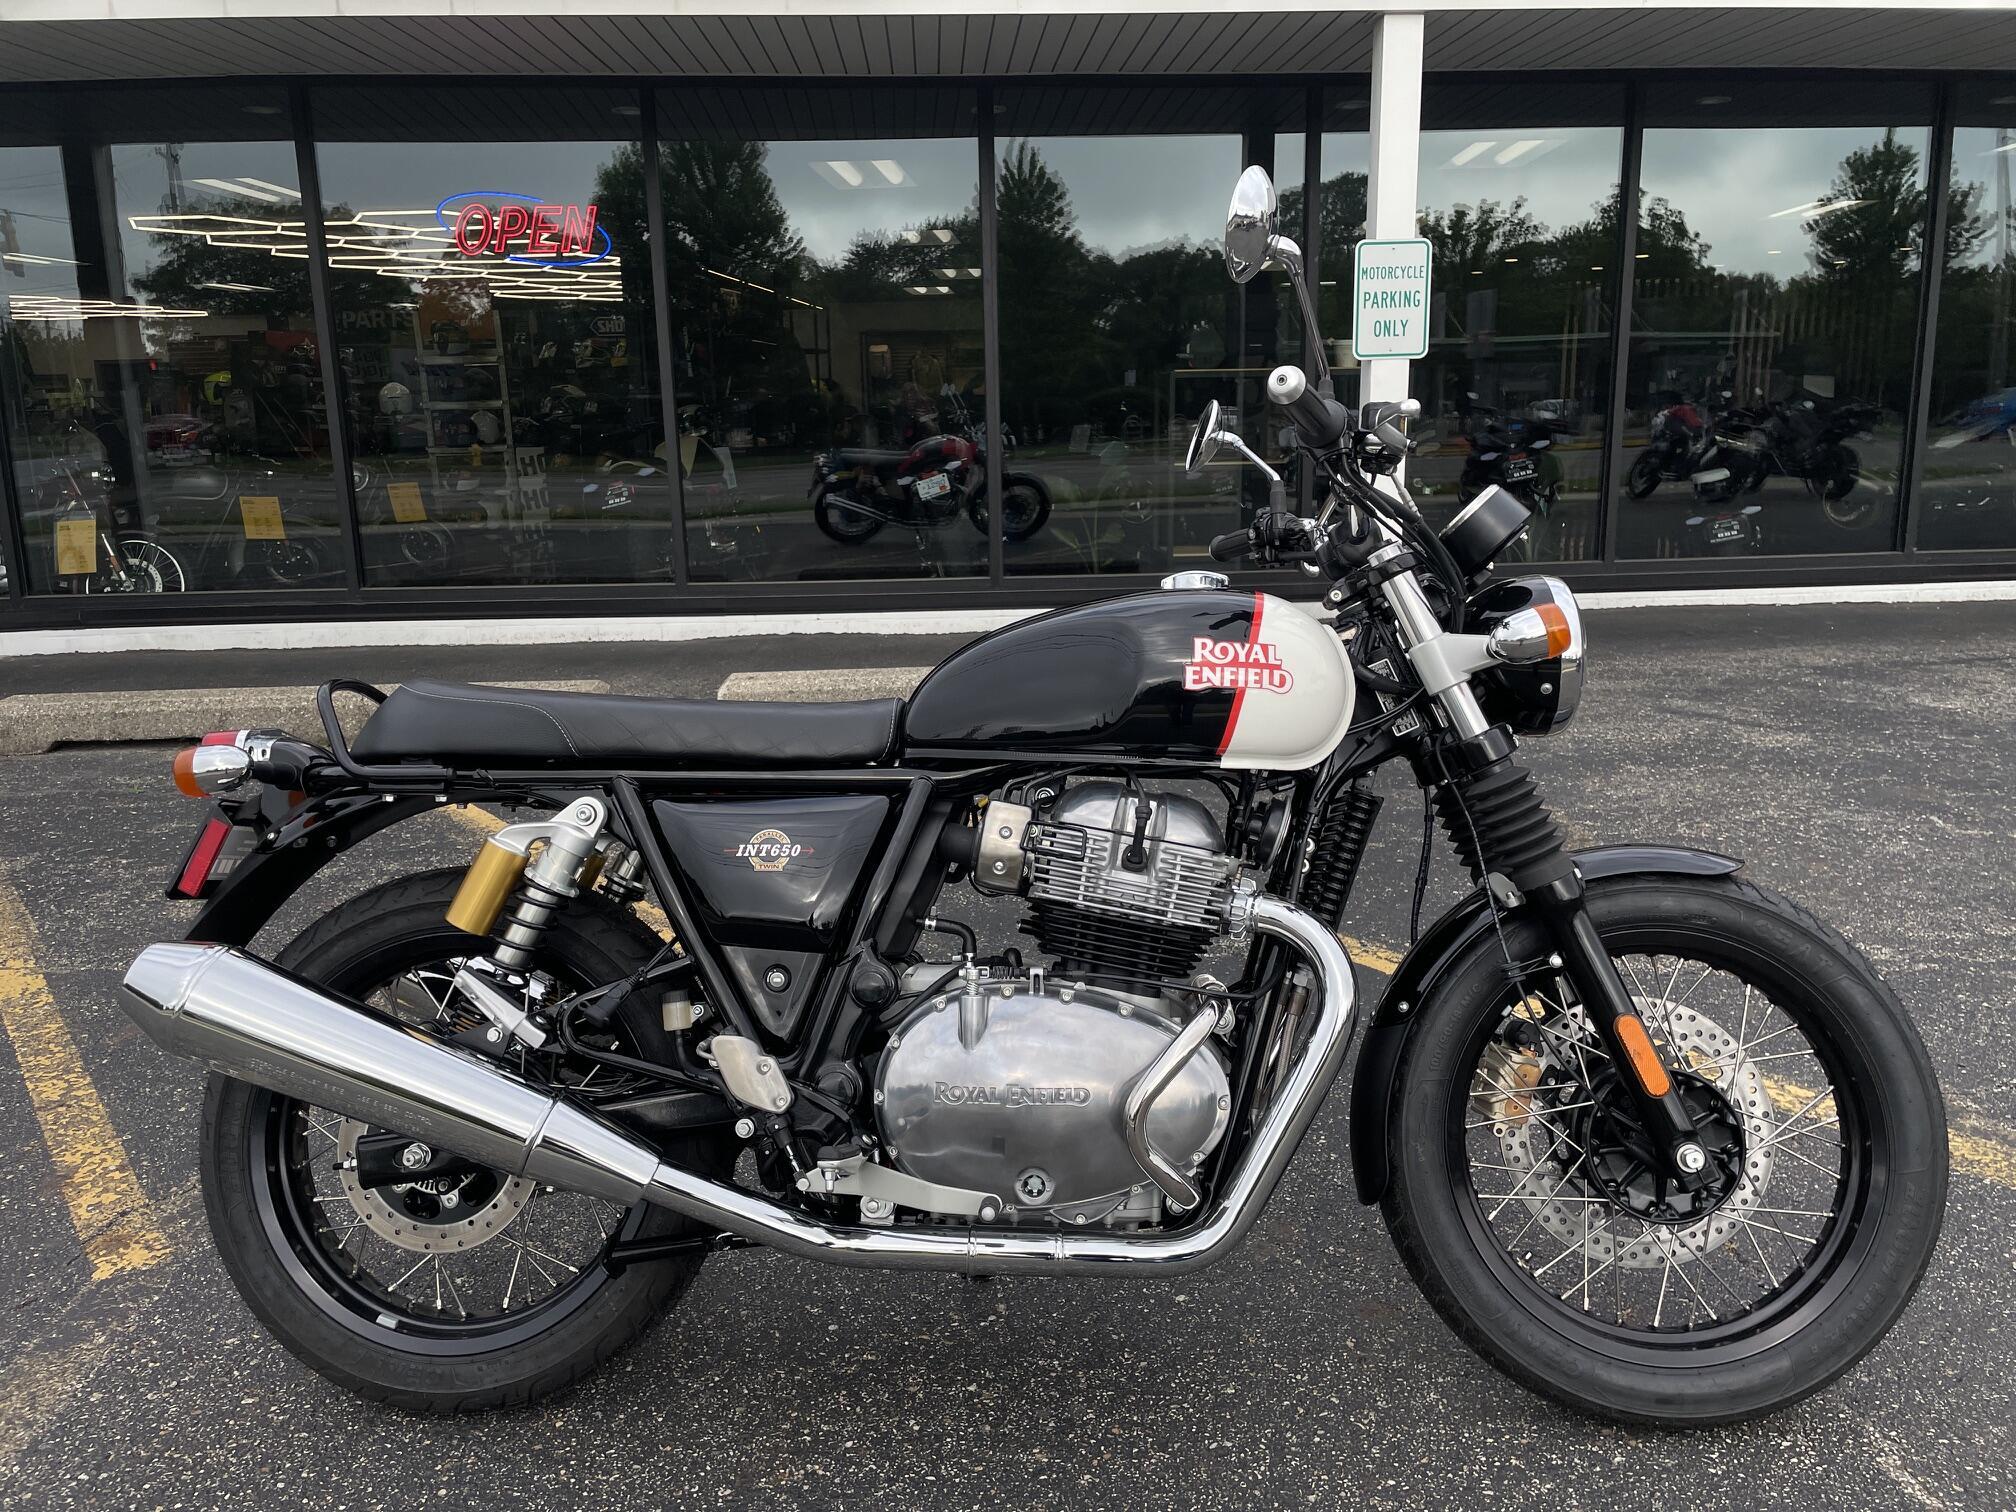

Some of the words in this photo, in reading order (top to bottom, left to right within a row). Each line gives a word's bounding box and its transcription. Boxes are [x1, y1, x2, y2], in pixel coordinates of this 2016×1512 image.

[455, 203, 597, 256] OPEN
[1361, 266, 1424, 280] MOTORCYCLE
[1364, 290, 1421, 309] PARKING
[1374, 320, 1409, 337] ONLY
[1192, 637, 1282, 665] ROYAL
[1184, 665, 1294, 693] ENFIELD
[736, 844, 801, 857] INT650
[934, 1081, 1002, 1105] ROYAL
[1006, 1083, 1091, 1108] ENFIELD
